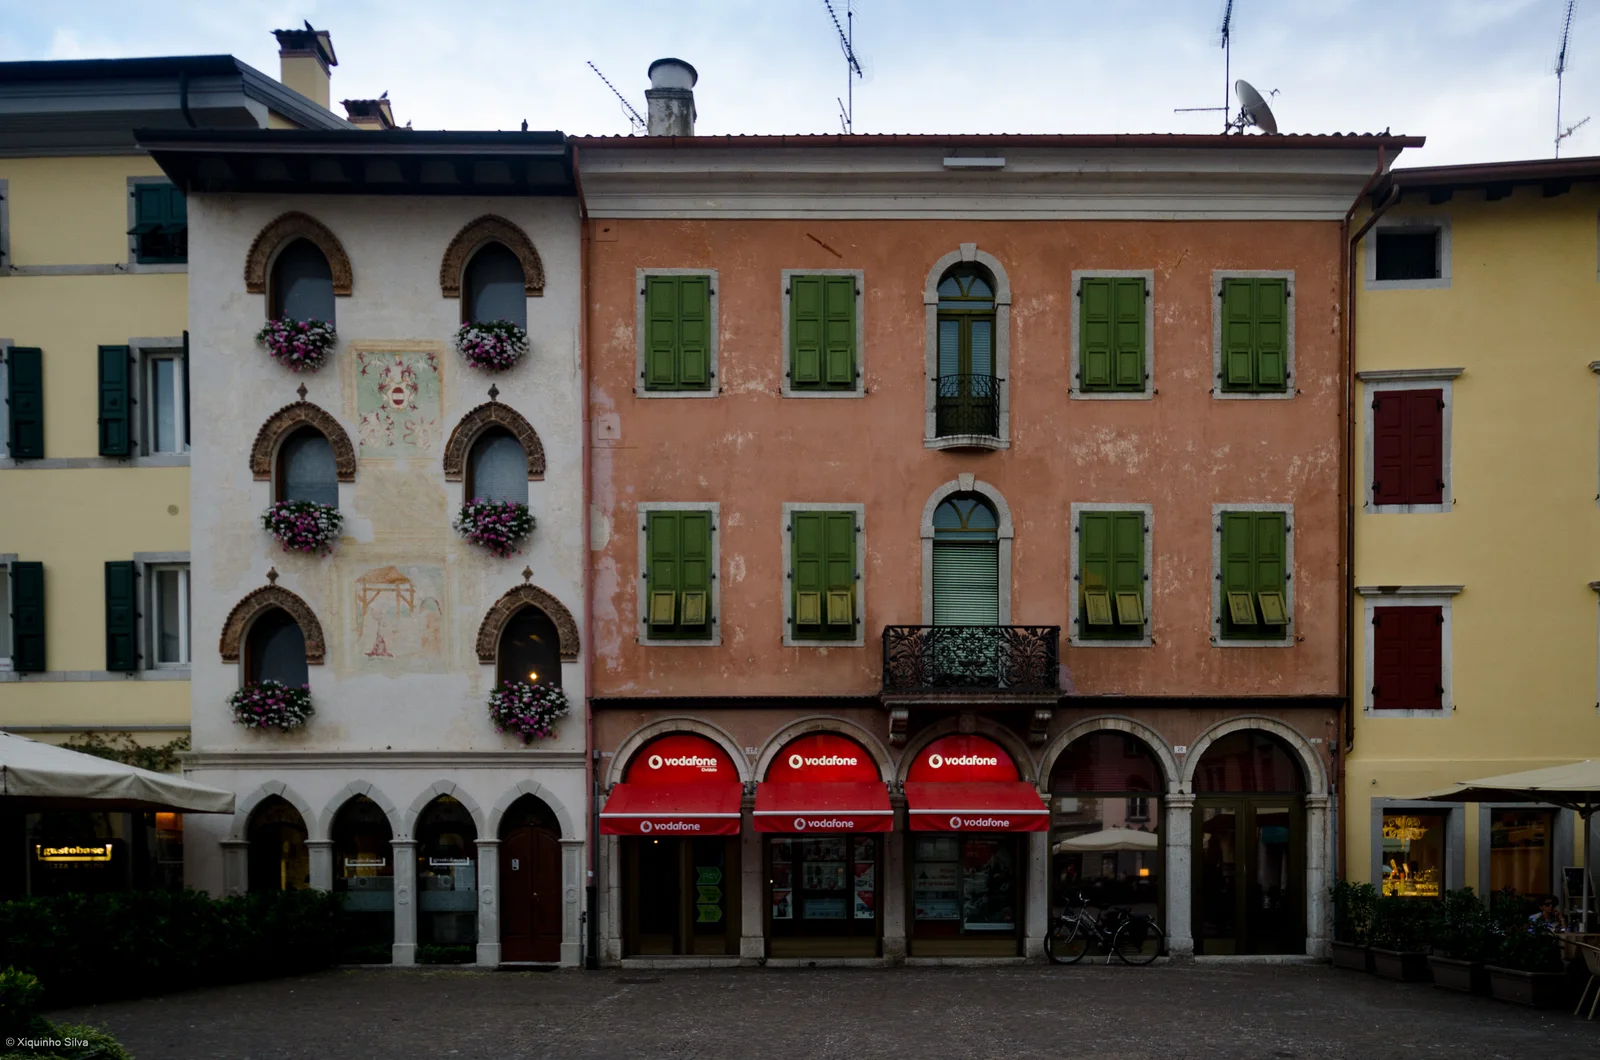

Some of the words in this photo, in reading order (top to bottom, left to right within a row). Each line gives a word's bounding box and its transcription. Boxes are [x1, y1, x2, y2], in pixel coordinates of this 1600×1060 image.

[664, 756, 717, 766] vodafone
[805, 755, 858, 766] vodafone
[945, 755, 997, 766] vodafone
[654, 821, 700, 831] vodafone
[808, 819, 854, 828] vodafone
[964, 818, 1010, 827] vodafone
[44, 846, 104, 855] gustobase
